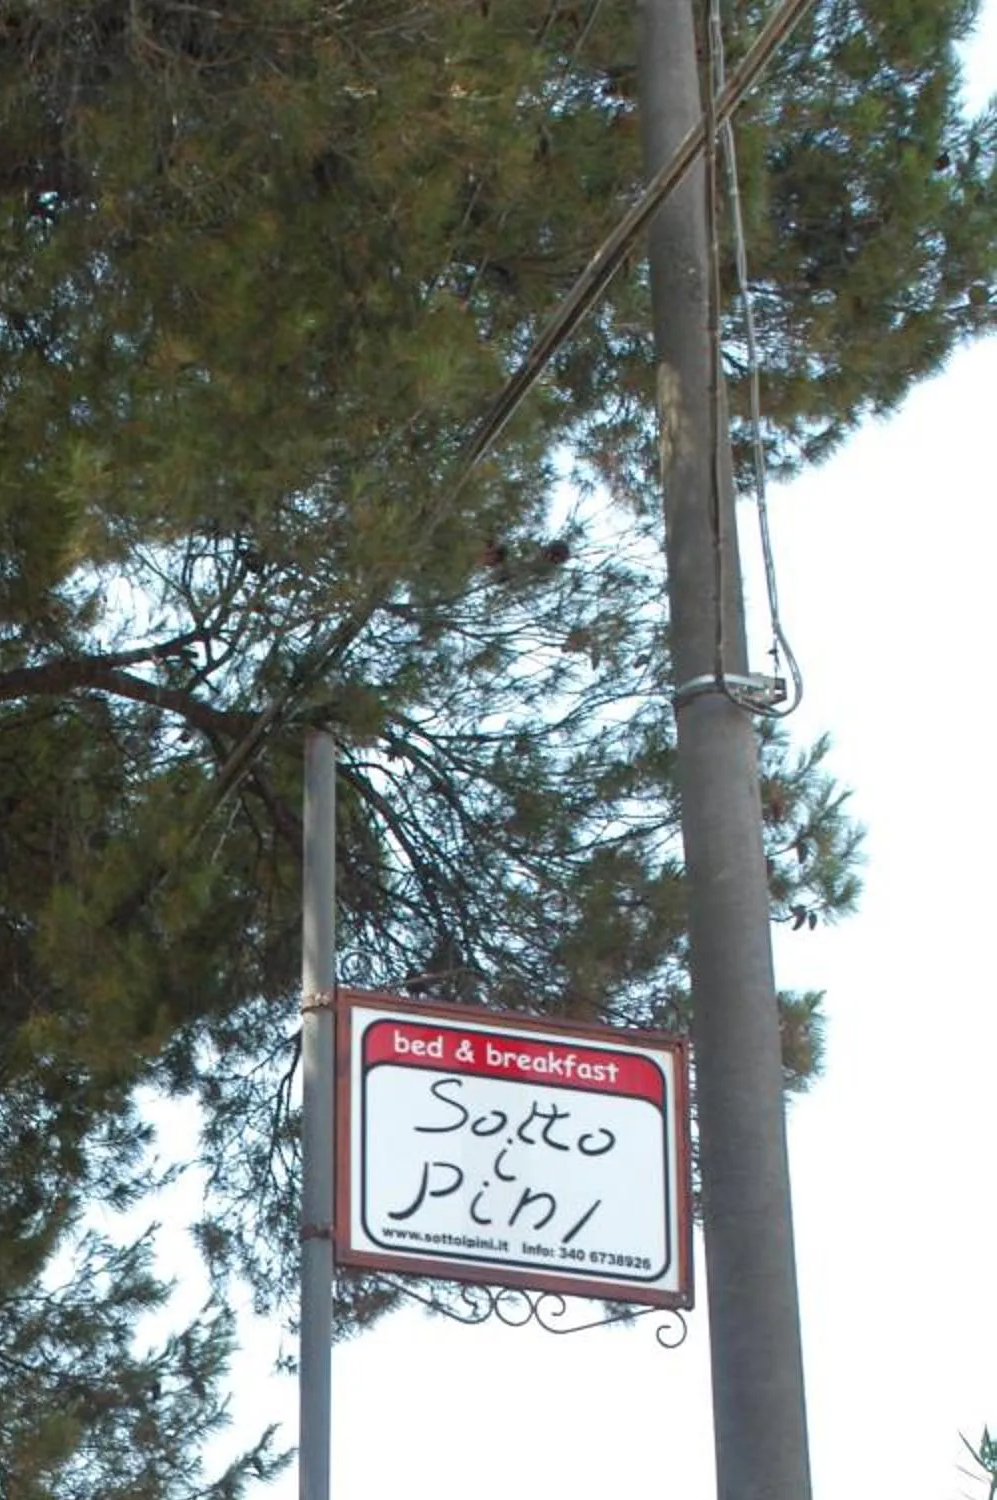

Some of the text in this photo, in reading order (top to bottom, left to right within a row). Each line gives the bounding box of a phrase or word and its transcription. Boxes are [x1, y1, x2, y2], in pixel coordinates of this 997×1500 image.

[393, 1031, 619, 1083] bed & breakfast
[415, 1078, 615, 1156] Sotto
[494, 1139, 516, 1181] i
[382, 1226, 509, 1252] www.sottoipini.it
[559, 1245, 585, 1261] 340
[589, 1251, 652, 1271] 6738926
